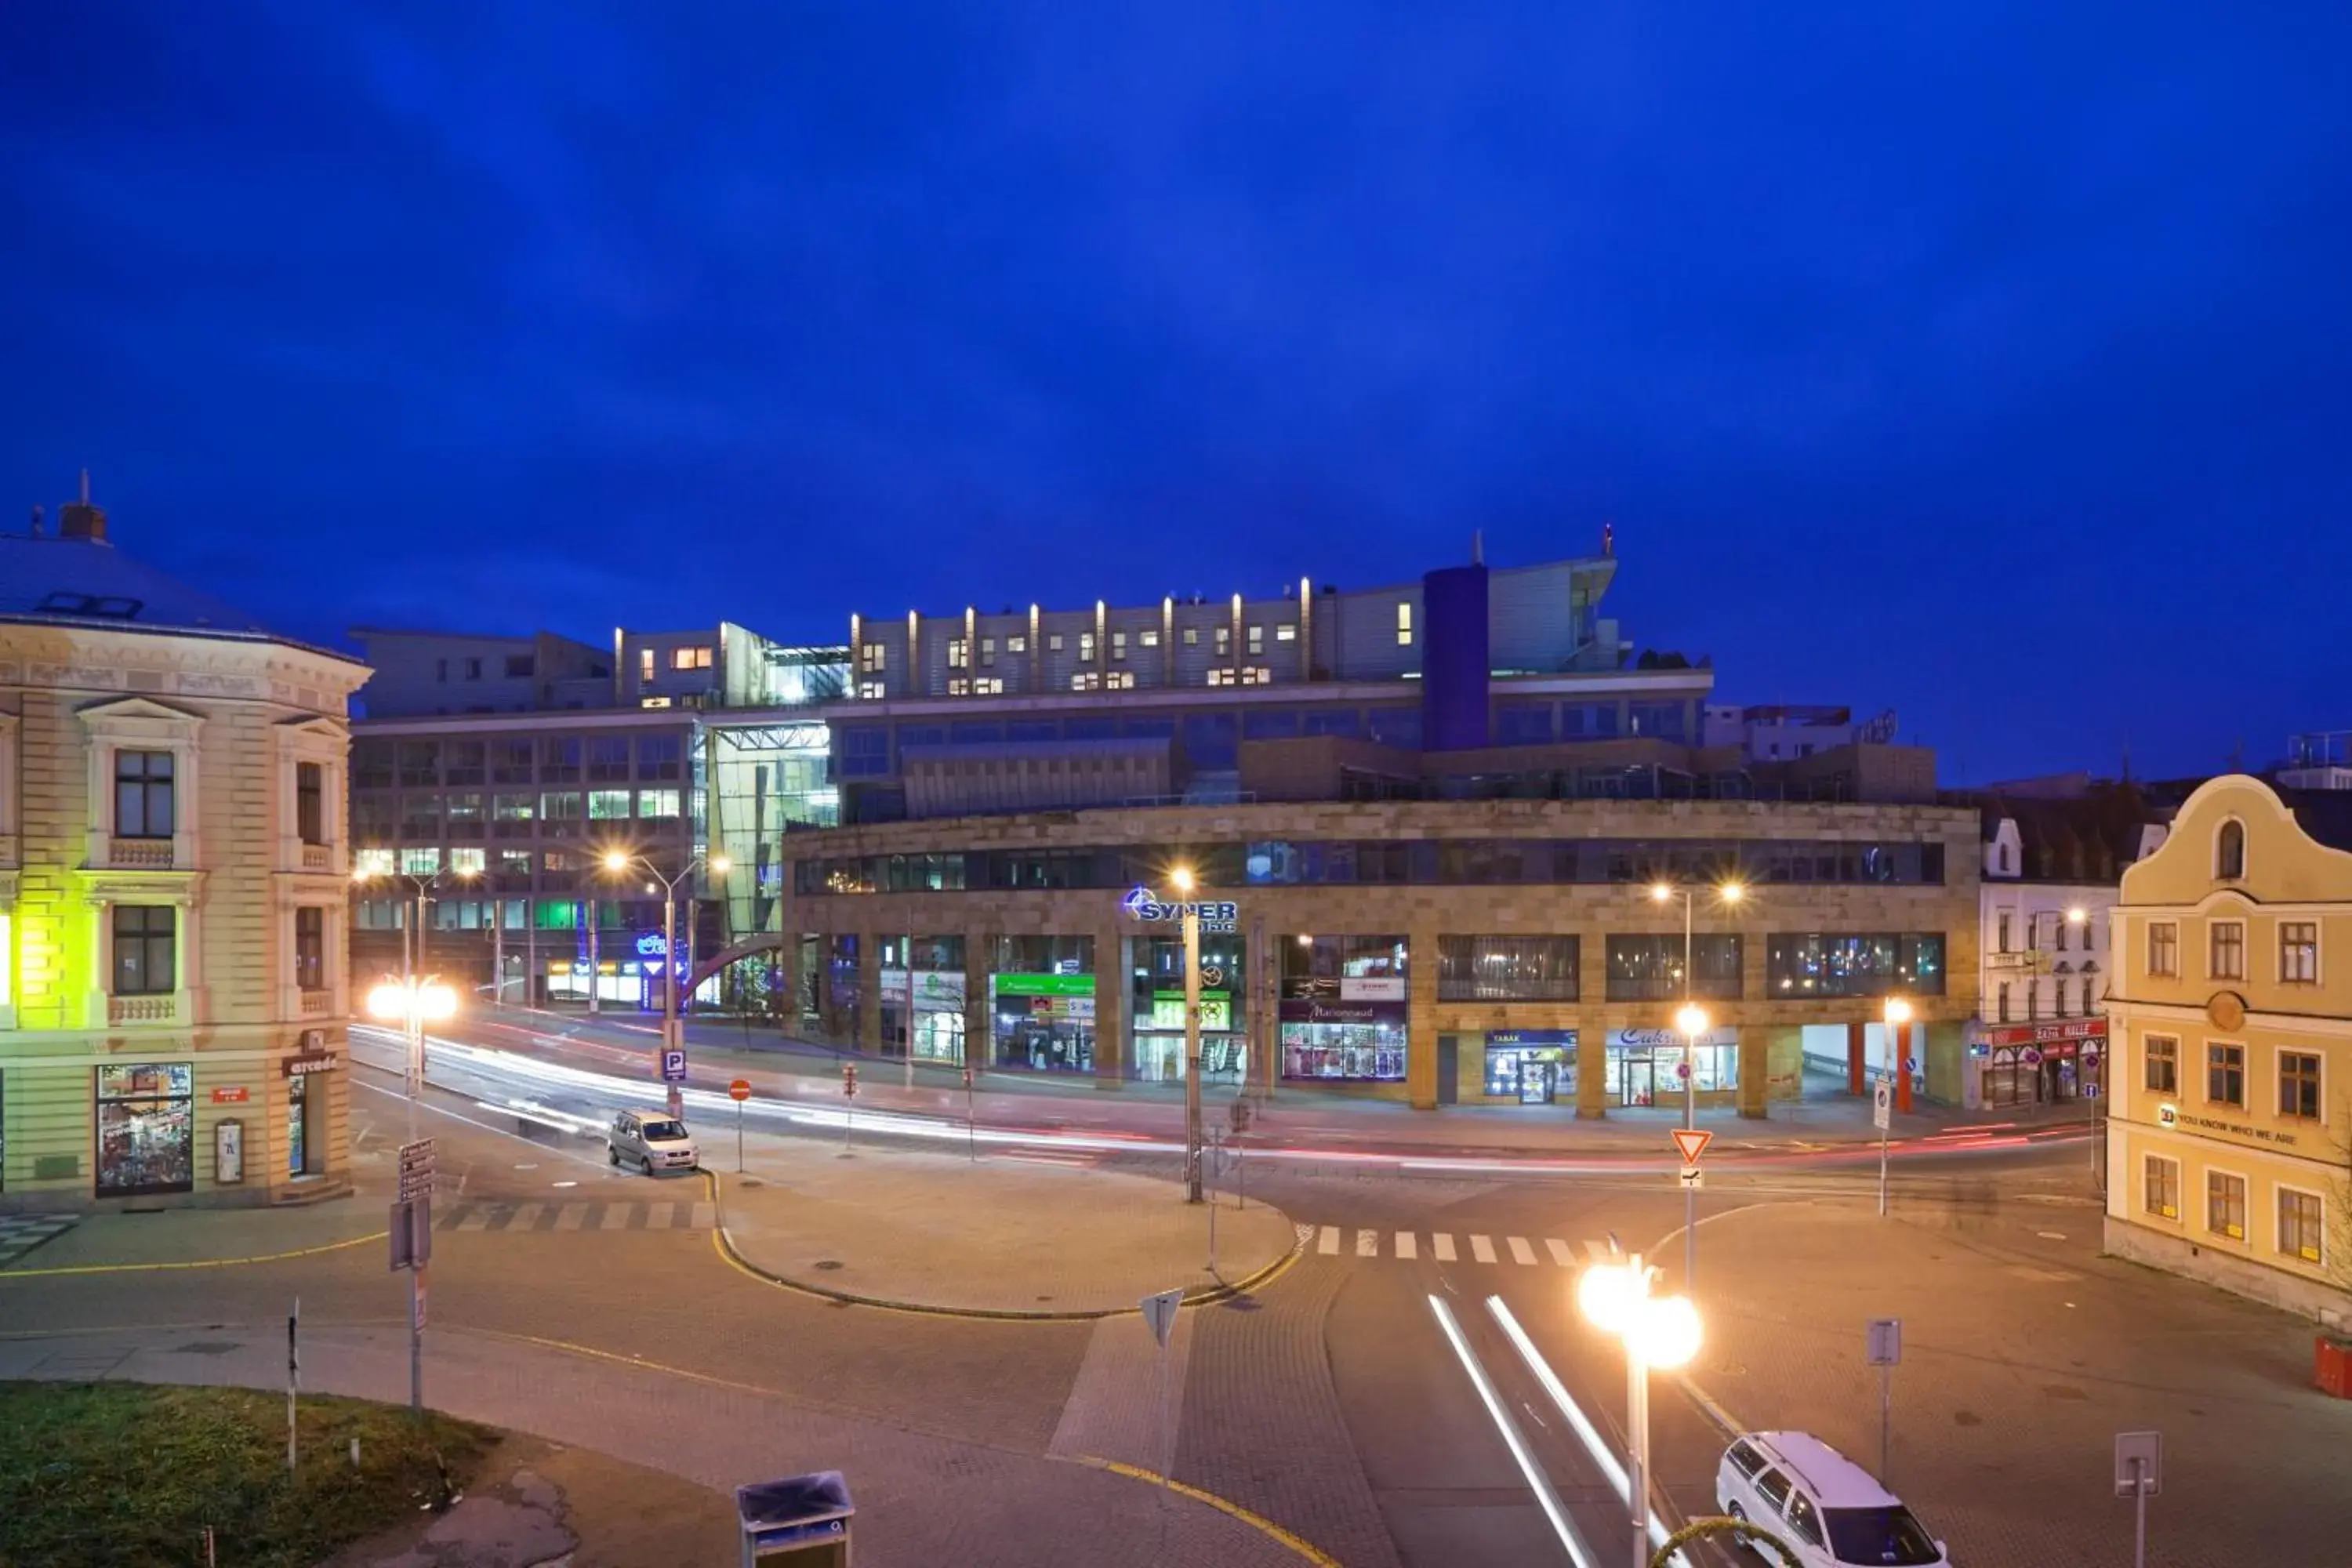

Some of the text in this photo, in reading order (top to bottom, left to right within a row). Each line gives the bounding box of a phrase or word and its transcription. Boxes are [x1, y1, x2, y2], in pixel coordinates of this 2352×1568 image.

[1141, 901, 1237, 921] SYNER
[1308, 1003, 1374, 1023] Marionnaud
[669, 1054, 681, 1068] P
[2179, 1114, 2198, 1125] YOU
[2199, 1118, 2227, 1131] KNOW
[2230, 1124, 2253, 1136] WHO
[2256, 1130, 2271, 1141] WE
[2275, 1133, 2297, 1145] ARE
